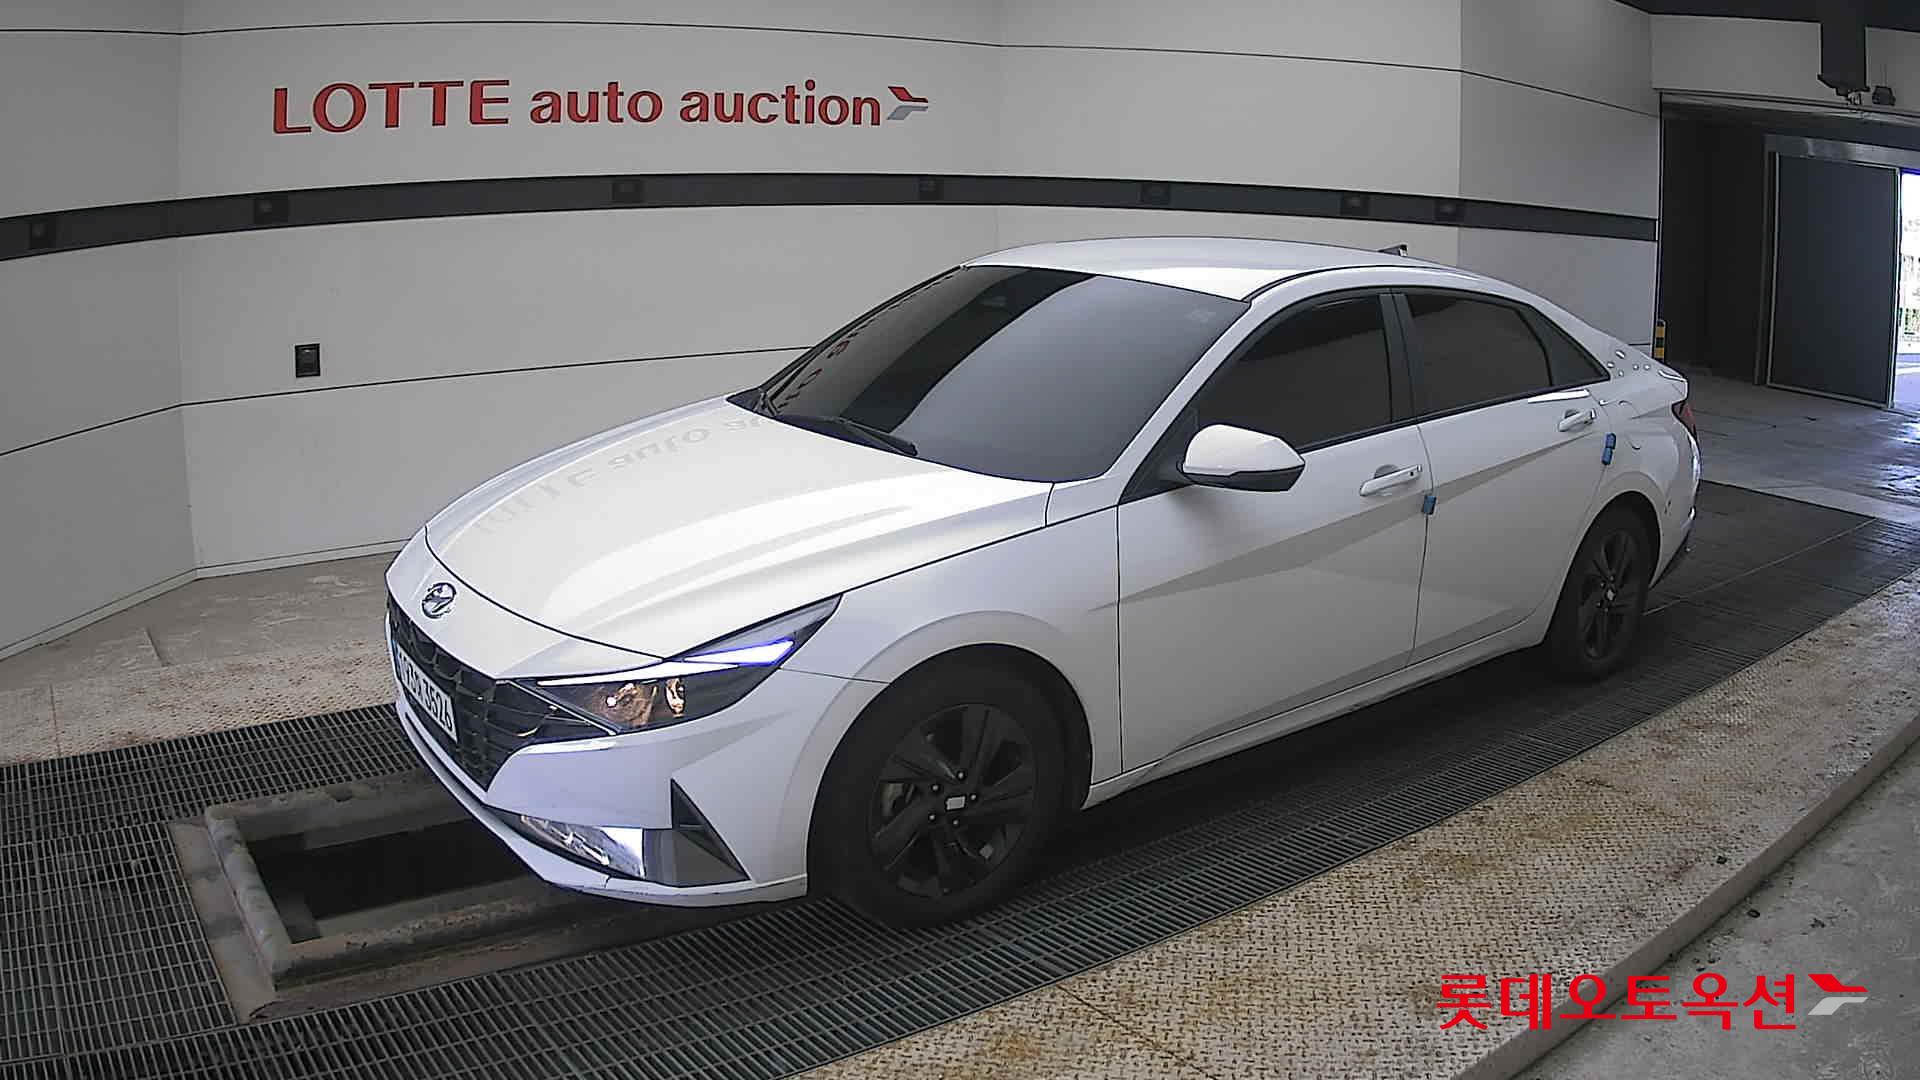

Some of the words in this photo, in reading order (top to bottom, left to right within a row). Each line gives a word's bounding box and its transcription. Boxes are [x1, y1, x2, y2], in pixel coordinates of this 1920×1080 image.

[273, 79, 510, 134] LOTTE
[530, 82, 663, 125] auto
[679, 79, 882, 126] auction
